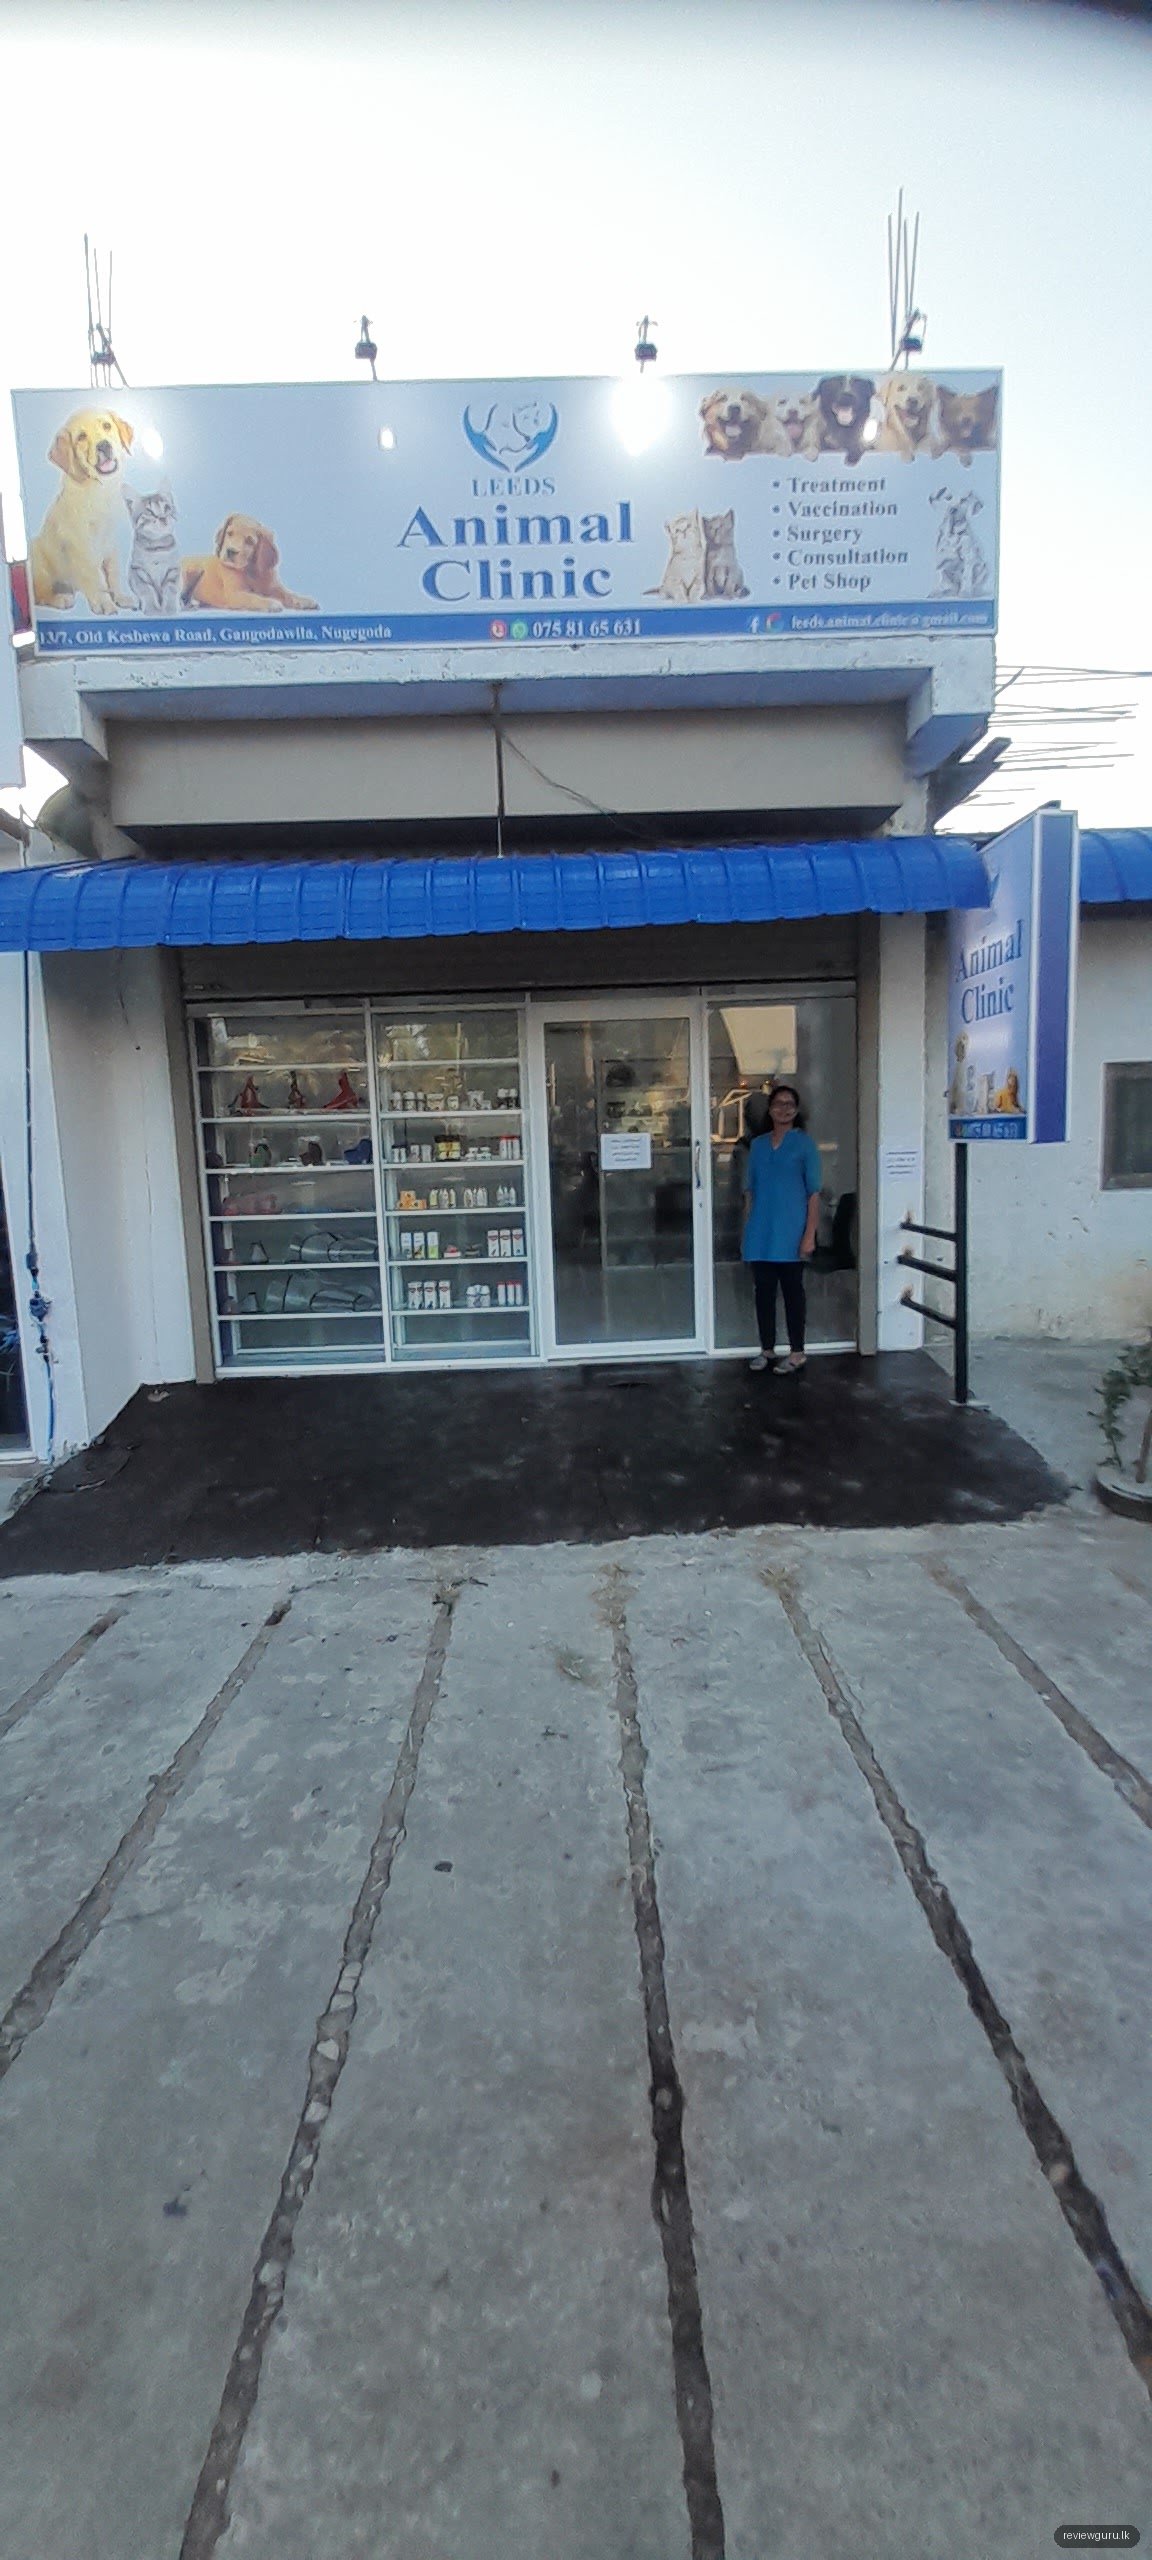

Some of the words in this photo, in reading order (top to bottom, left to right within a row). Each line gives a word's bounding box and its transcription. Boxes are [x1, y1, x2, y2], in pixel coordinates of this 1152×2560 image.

[472, 477, 556, 498] LEEDS
[787, 476, 886, 494] Treatment
[788, 501, 898, 518] Vaccination
[396, 500, 636, 548] Animal
[786, 526, 863, 545] Surgery
[787, 549, 909, 568] Consultation
[422, 557, 613, 602] Clinic
[789, 573, 817, 590] Pet
[824, 572, 871, 592] Shop
[75, 629, 103, 644] Old
[321, 623, 392, 641] Nugegoda
[532, 619, 562, 639] 075
[566, 618, 585, 637] 81
[589, 618, 610, 637] 65
[613, 617, 641, 636] 631
[956, 919, 1022, 983] Animal
[961, 977, 1015, 1024] Clinic
